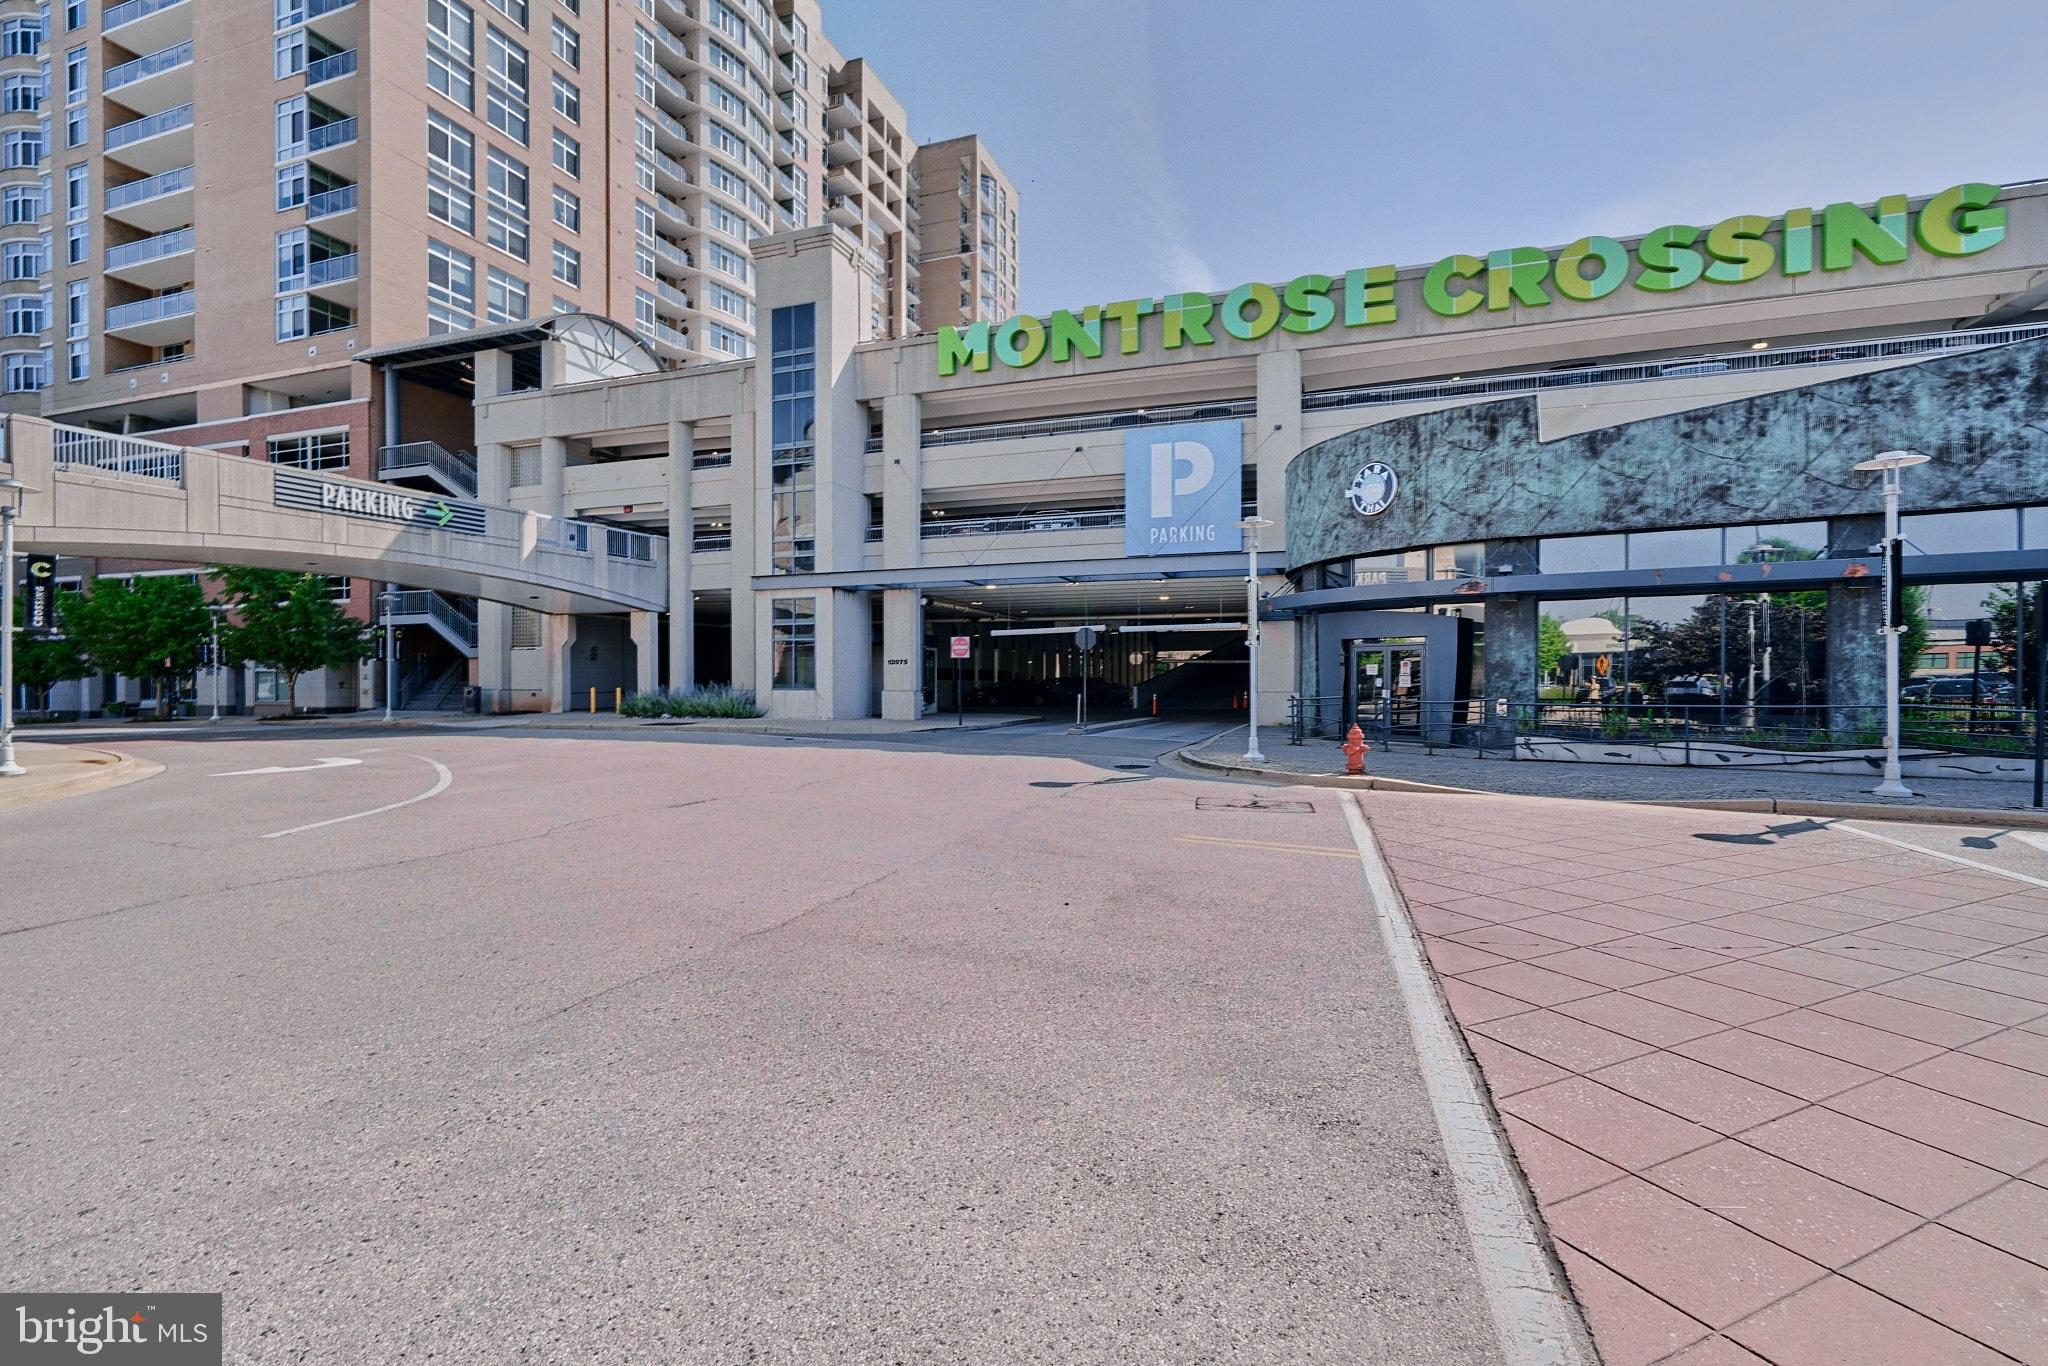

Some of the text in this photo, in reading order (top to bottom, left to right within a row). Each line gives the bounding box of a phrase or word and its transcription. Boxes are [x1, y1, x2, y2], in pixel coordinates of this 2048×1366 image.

[938, 183, 2006, 376] MONTROSE CROSSING
[1151, 441, 1215, 518] P
[322, 483, 416, 520] PARKING
[1360, 499, 1386, 513] THAI
[1150, 524, 1215, 544] PARKING
[31, 561, 52, 578] C
[32, 585, 46, 627] CROSSING
